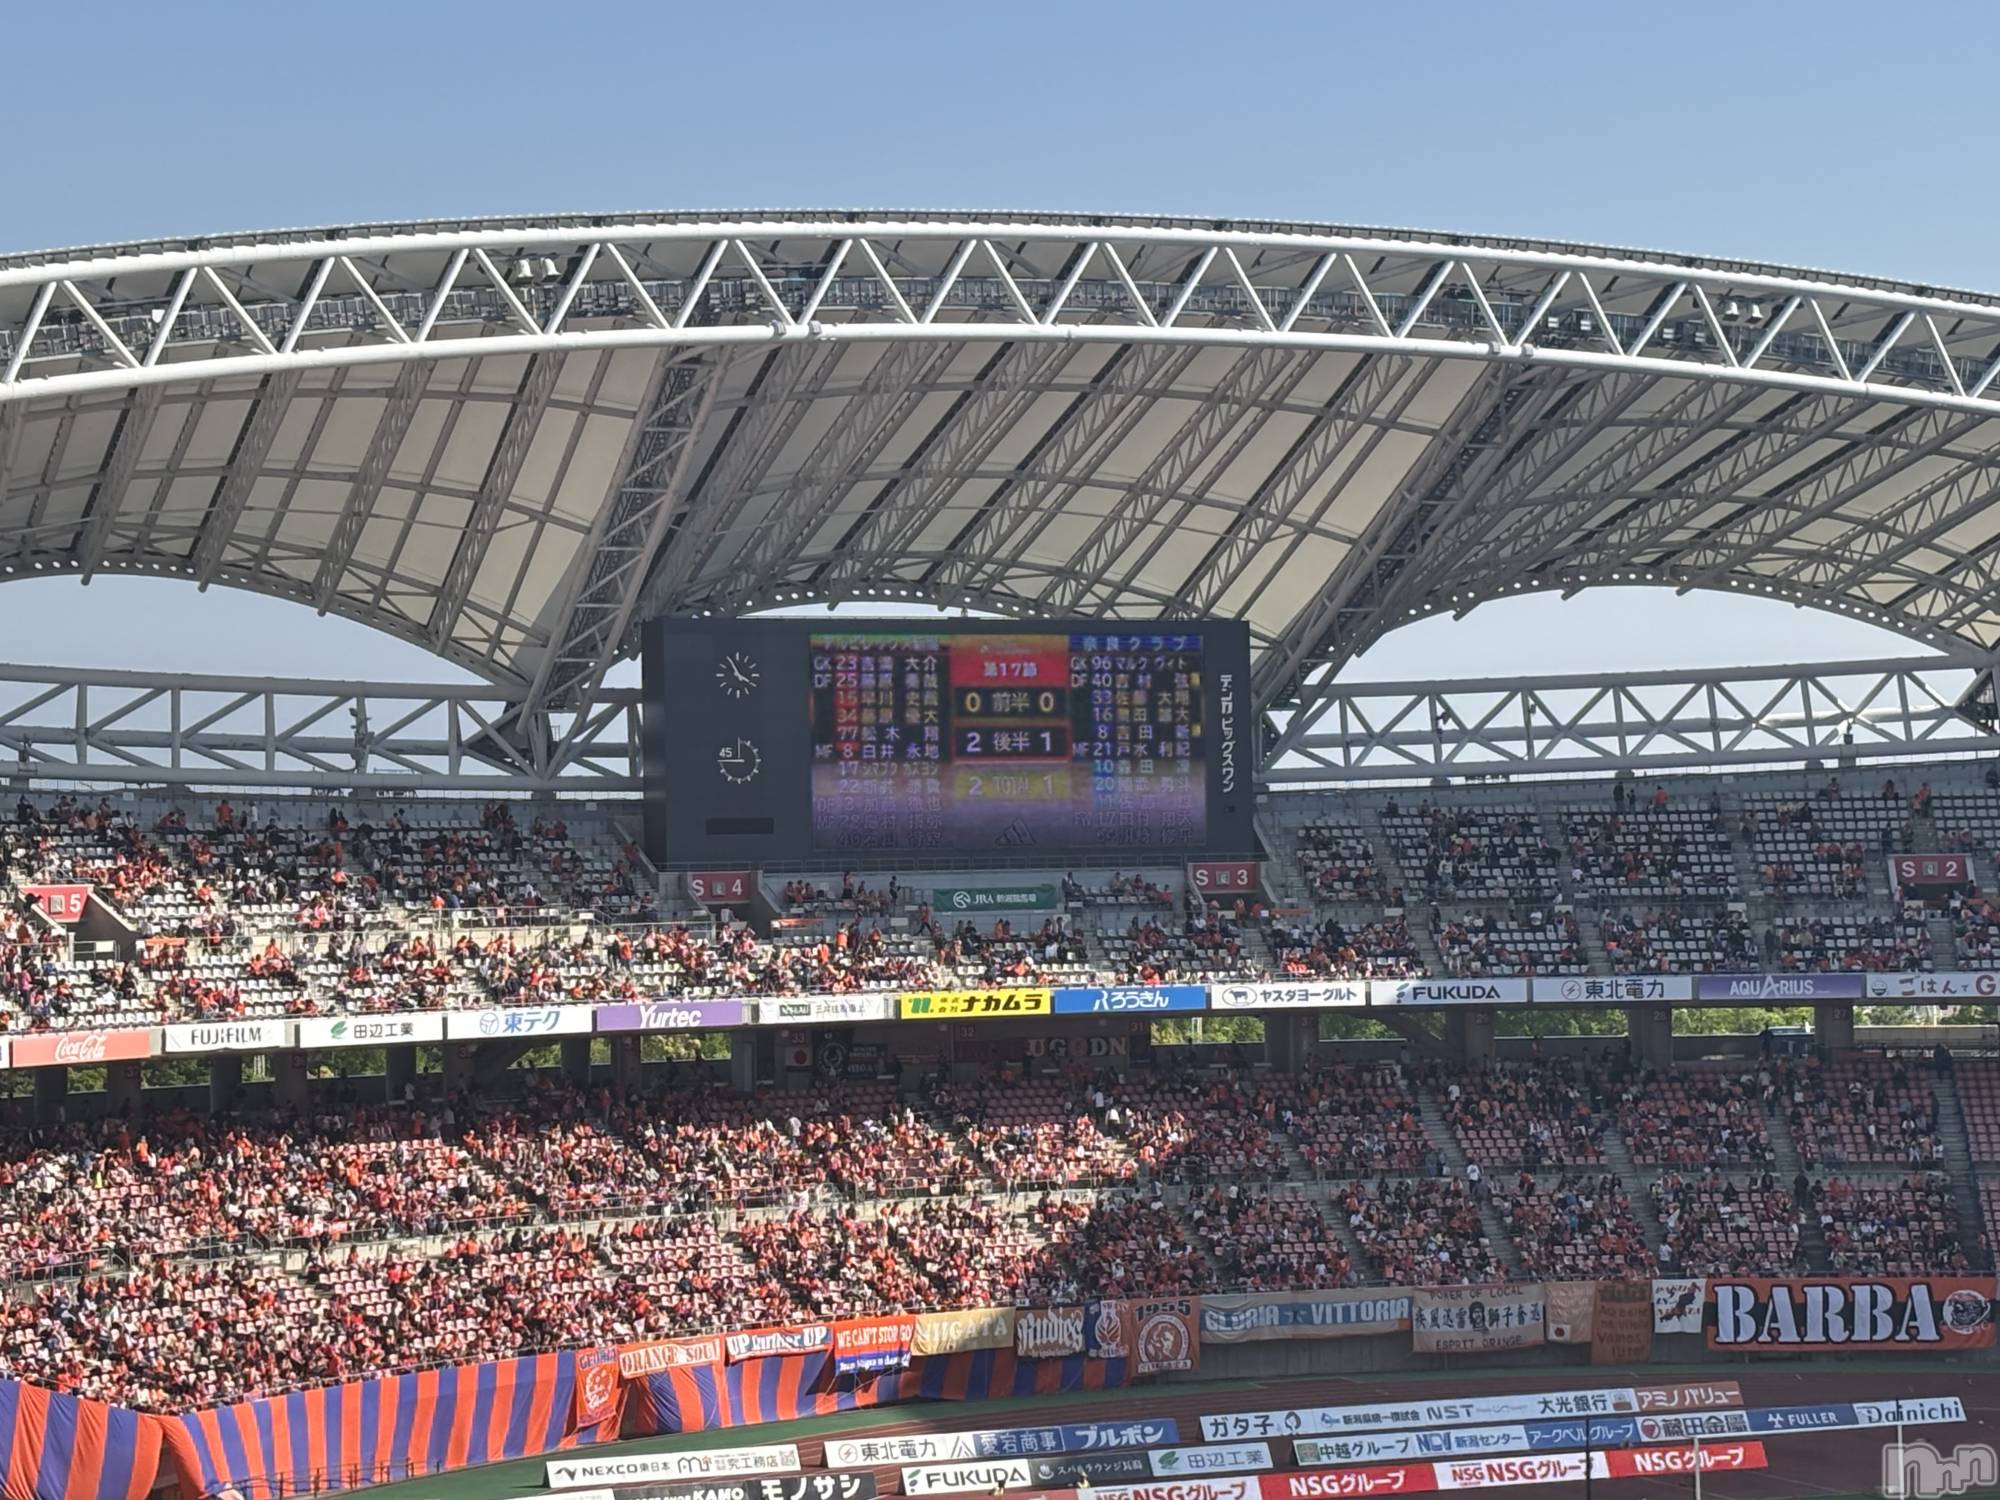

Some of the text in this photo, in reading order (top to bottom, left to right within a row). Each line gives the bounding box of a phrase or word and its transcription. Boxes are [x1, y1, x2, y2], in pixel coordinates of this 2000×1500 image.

[836, 656, 857, 671] 23
[905, 656, 938, 671] 大介
[1092, 656, 1112, 671] 96
[836, 673, 857, 688] 25
[1092, 673, 1112, 687] 40
[837, 691, 857, 706] 15
[966, 692, 1054, 713] 0 前半 0
[1093, 690, 1112, 704] 33
[837, 708, 857, 723] 34
[1093, 707, 1112, 722] 16
[838, 726, 858, 741] 77
[1098, 725, 1108, 739] 8
[1220, 674, 1237, 793] デンカビッグスワン
[843, 743, 854, 758] 8
[863, 743, 894, 759] 白井
[966, 732, 1051, 752] 2 後半 1
[1093, 742, 1112, 756] 21
[719, 747, 733, 758] 45
[839, 761, 859, 776] 17
[1095, 760, 1113, 774] 10
[969, 776, 983, 795] 2
[1043, 776, 1053, 794] 1
[1095, 777, 1114, 791] 20
[1195, 869, 1248, 886] S 3
[1902, 861, 1957, 878] S 2
[692, 879, 743, 896] S 4
[70, 893, 81, 913] 5
[1260, 983, 1357, 1003] ヤスダヨーグルト
[1412, 985, 1501, 1001] FUKUDA
[1584, 980, 1665, 1000] 東北電力
[1729, 975, 1814, 998] AQUARIUS
[960, 994, 1043, 1013] ナカムラ
[1109, 991, 1169, 1009] ろうきん
[504, 1011, 560, 1033] 東テク
[639, 1004, 702, 1028] Yurtec
[191, 1026, 262, 1046] FUJIFILM
[354, 1022, 414, 1039] 田辺工業
[792, 1032, 806, 1043] 33
[1469, 1288, 1483, 1299] OF
[1489, 1286, 1523, 1298] LOCAL
[1136, 1300, 1191, 1323] 1955
[1311, 1299, 1409, 1324] VITTORIA
[1712, 1284, 1942, 1344] BARBA
[727, 1333, 751, 1356] UP
[802, 1326, 828, 1347] UP
[836, 1330, 851, 1350] WE
[852, 1327, 877, 1347] CAN'T
[878, 1325, 899, 1345] STOP
[1483, 1335, 1522, 1349] ORANGE
[621, 1346, 680, 1374] ORANGE
[1426, 1404, 1475, 1421] NST
[1537, 1394, 1608, 1415] 大光銀行
[1866, 1401, 1961, 1424] Dainichi
[1209, 1415, 1275, 1438] ガタ子
[1788, 1412, 1840, 1427] FULLER
[980, 1430, 1057, 1455] 愛宕商事
[1075, 1425, 1165, 1449] ブルボン
[1454, 1434, 1523, 1449] 新潟センター
[1529, 1423, 1635, 1444] アークベルグループ
[860, 1439, 938, 1462] 東北電力
[1319, 1438, 1411, 1459] 中越グループ
[1187, 1450, 1266, 1469] 田辺工業
[1451, 1456, 1595, 1482] NSG NSGグループ
[1634, 1447, 1744, 1472] NSGグループ
[582, 1461, 672, 1478] NEXCO東日本
[926, 1467, 1026, 1488] FUKUDA
[694, 1486, 746, 1500] KAMO
[760, 1475, 862, 1500] モノサシ
[1288, 1470, 1406, 1497] NSGグループ
